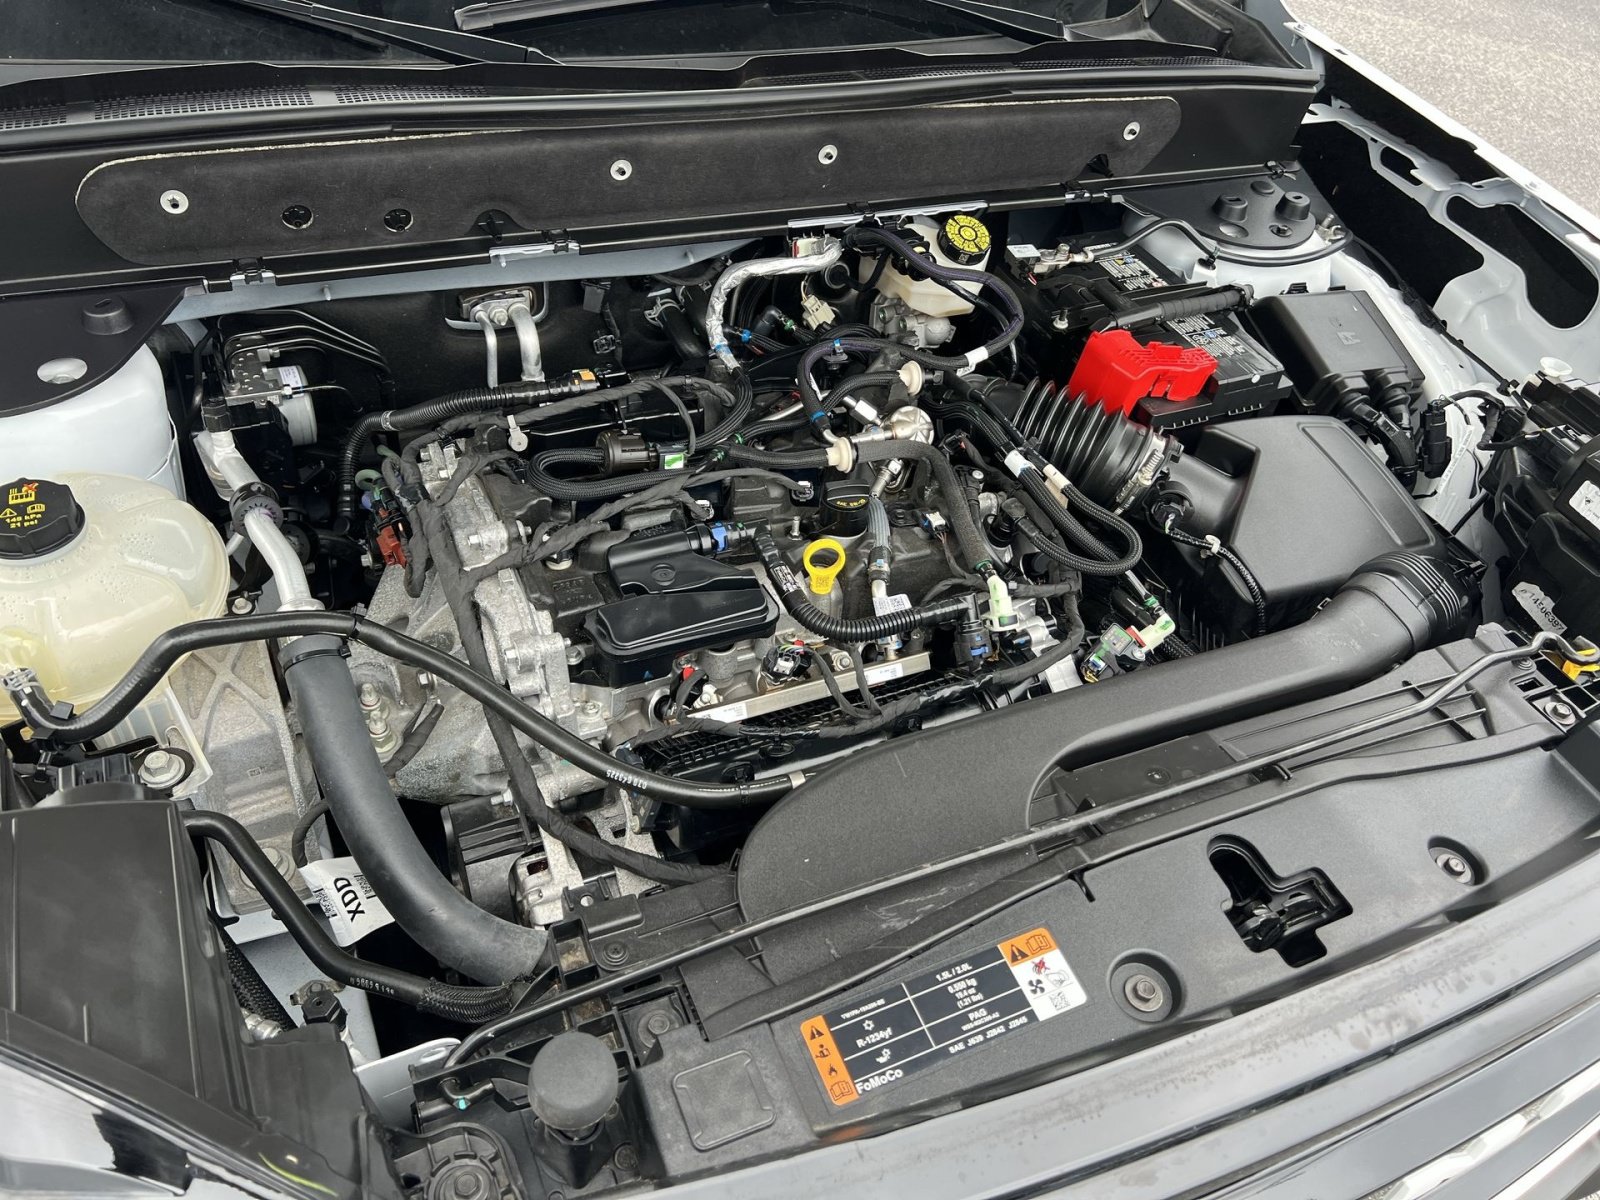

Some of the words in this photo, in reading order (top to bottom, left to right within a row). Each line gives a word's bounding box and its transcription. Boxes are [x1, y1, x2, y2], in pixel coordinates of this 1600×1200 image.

[334, 877, 366, 923] XDD
[936, 970, 953, 982] 1.5L
[955, 963, 973, 974] 2.0L
[965, 977, 978, 988] kg
[968, 1008, 987, 1021] PAG
[855, 1027, 893, 1048] R-1234yf
[948, 1041, 966, 1054] SAE
[967, 1034, 984, 1047] J639
[855, 1068, 904, 1095] FoMoCo
